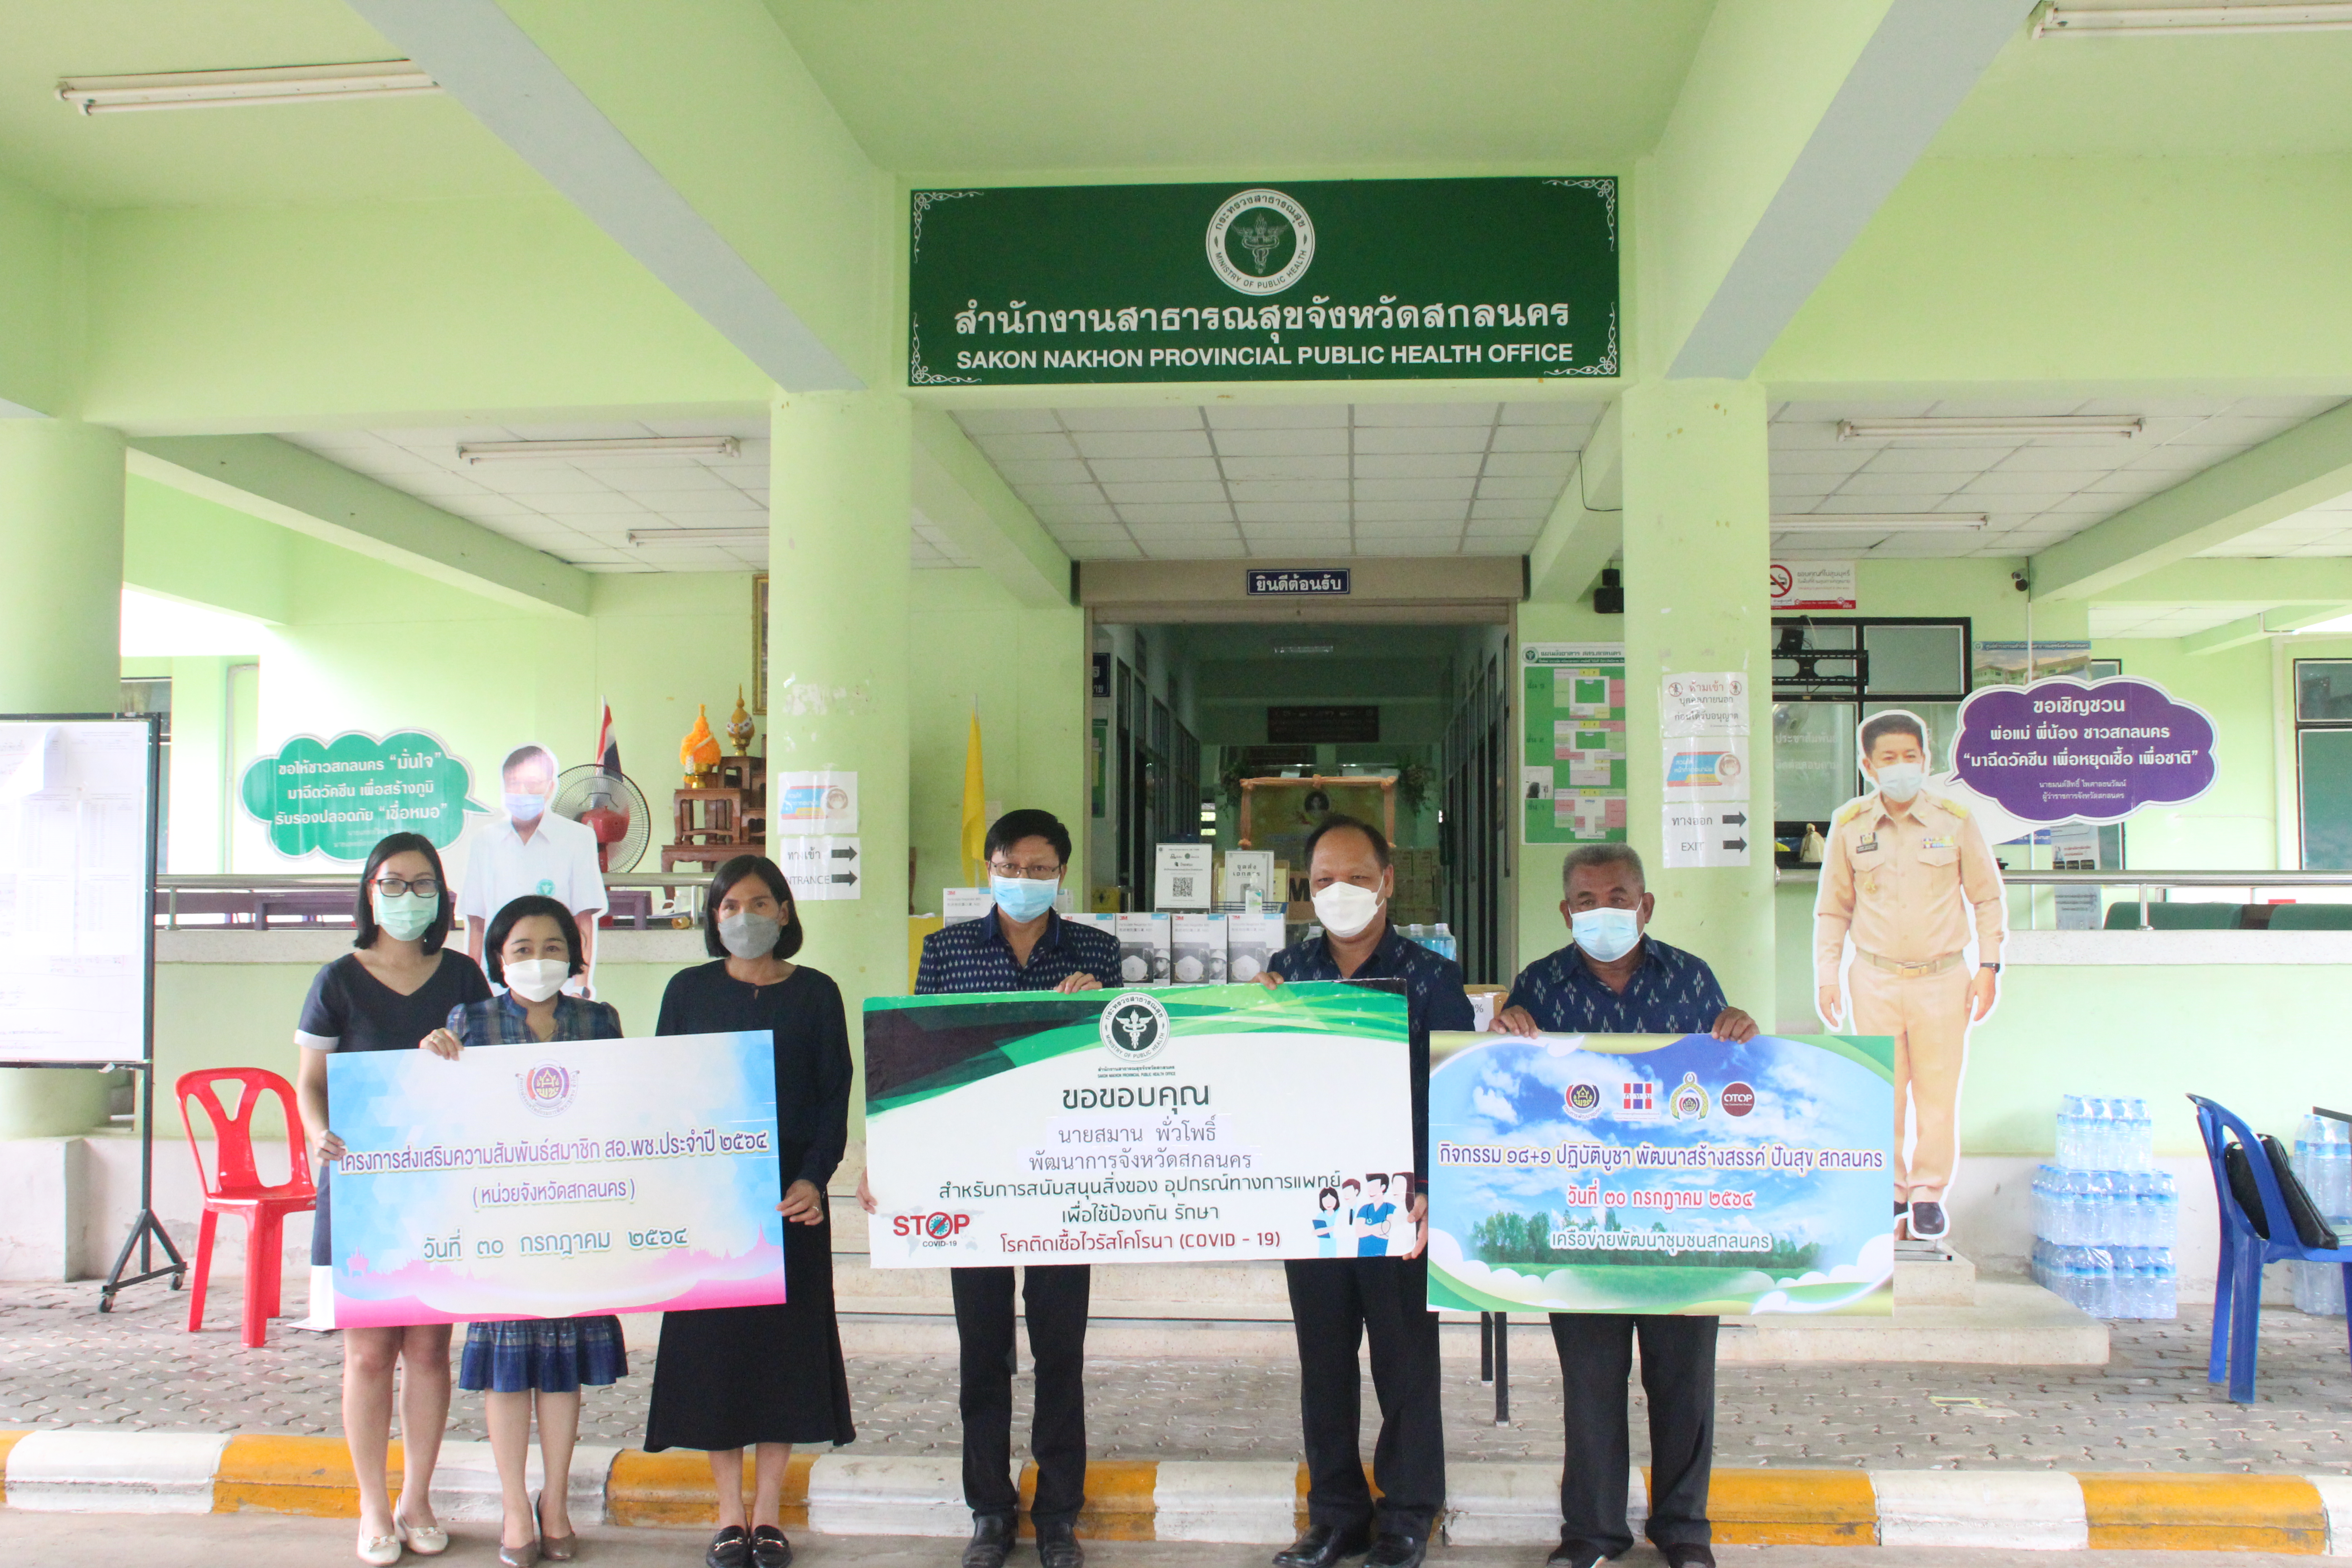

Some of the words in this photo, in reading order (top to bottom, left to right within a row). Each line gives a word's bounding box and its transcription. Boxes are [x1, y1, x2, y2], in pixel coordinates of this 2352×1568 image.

[1216, 195, 1305, 230] กระทรวงสาธารณสุข
[1215, 251, 1242, 283] MINISTRY
[1243, 279, 1254, 289] OF
[1257, 275, 1286, 289] PUBLIC
[1287, 250, 1307, 278] HEALTH
[954, 294, 1569, 344] สำนักงานสาธารณสุขจังหวัดสกลนคร
[957, 350, 1037, 369] SAKON
[1044, 349, 1143, 368] NAKHON
[1150, 347, 1292, 367] PROVINCIAL
[1298, 346, 1385, 364] PUBLIC
[1391, 344, 1482, 363] HEALTH
[1488, 343, 1573, 362] OFFICE
[1256, 573, 1341, 591] ยินดีต้อนรับ
[2034, 696, 2125, 716] ขอเชิญชวน
[1990, 722, 2030, 740] พ่อแม่
[2036, 721, 2078, 740] พี่น้อง
[2084, 726, 2170, 738] ชาวสกลนคร
[278, 759, 385, 775] ขอให้ชาวสกลนคร
[2053, 746, 2132, 769] เพื่อหยุดเชื้อ
[287, 784, 355, 799] มาฉีดวัคซีน
[360, 779, 434, 797] เพื่อสร้างภูมิ
[275, 809, 373, 825] รับรองปลอดภัย
[1672, 817, 1712, 826] ทางออก
[1681, 842, 1705, 851] EXIT
[785, 875, 830, 885] NTRANCE
[1106, 996, 1163, 1020] กระทรวงสาธารณสุข
[1106, 1034, 1123, 1054] MINISTRY
[1133, 1050, 1152, 1058] PUBLIC
[1152, 1033, 1165, 1051] HEALTH
[1063, 1085, 1209, 1115] ขอขอบคุณ
[1724, 1094, 1752, 1102] OTOP
[1058, 1128, 1142, 1143] นายสมาน
[1156, 1114, 1216, 1142] พั่วโพธิ์
[720, 1132, 767, 1151] ๒๕๖๔
[1029, 1147, 1252, 1171] พัฒนาการจังหวัดสกลนคร
[1440, 1144, 1501, 1163] กิจกรรม
[1557, 1144, 1630, 1171] ปฏิบัติบูชา
[1637, 1145, 1765, 1165] พัฒนาสร้างสรรค์
[1819, 1151, 1882, 1167] สกลนคร
[482, 1181, 626, 1204] หน่วยจังหวัดสกลนคร
[939, 1172, 1157, 1200] สำหรับการสนับสนุนสิ่งของ
[1165, 1170, 1341, 1198] อุปกรณ์ทางการแพทย์
[1568, 1180, 1597, 1205] วันที่
[1605, 1193, 1626, 1205] ๓๐
[1710, 1191, 1752, 1205] ๒๕๖๔
[1063, 1200, 1167, 1223] เพื่อใช้ป้องกัน
[1175, 1203, 1219, 1220] รักษา
[893, 1211, 970, 1240] STOP
[424, 1229, 461, 1259] วันที่
[477, 1240, 504, 1254] ๓๐
[628, 1228, 687, 1246] ๒๕๖๔
[1001, 1230, 1173, 1252] โรคติดเชื้อไวรัสโคโรนา
[1180, 1234, 1235, 1250] (COVID
[1257, 1232, 1281, 1248] 19)
[1553, 1230, 1769, 1251] เครือข่ายพัฒนาชุมชนสกลนคร
